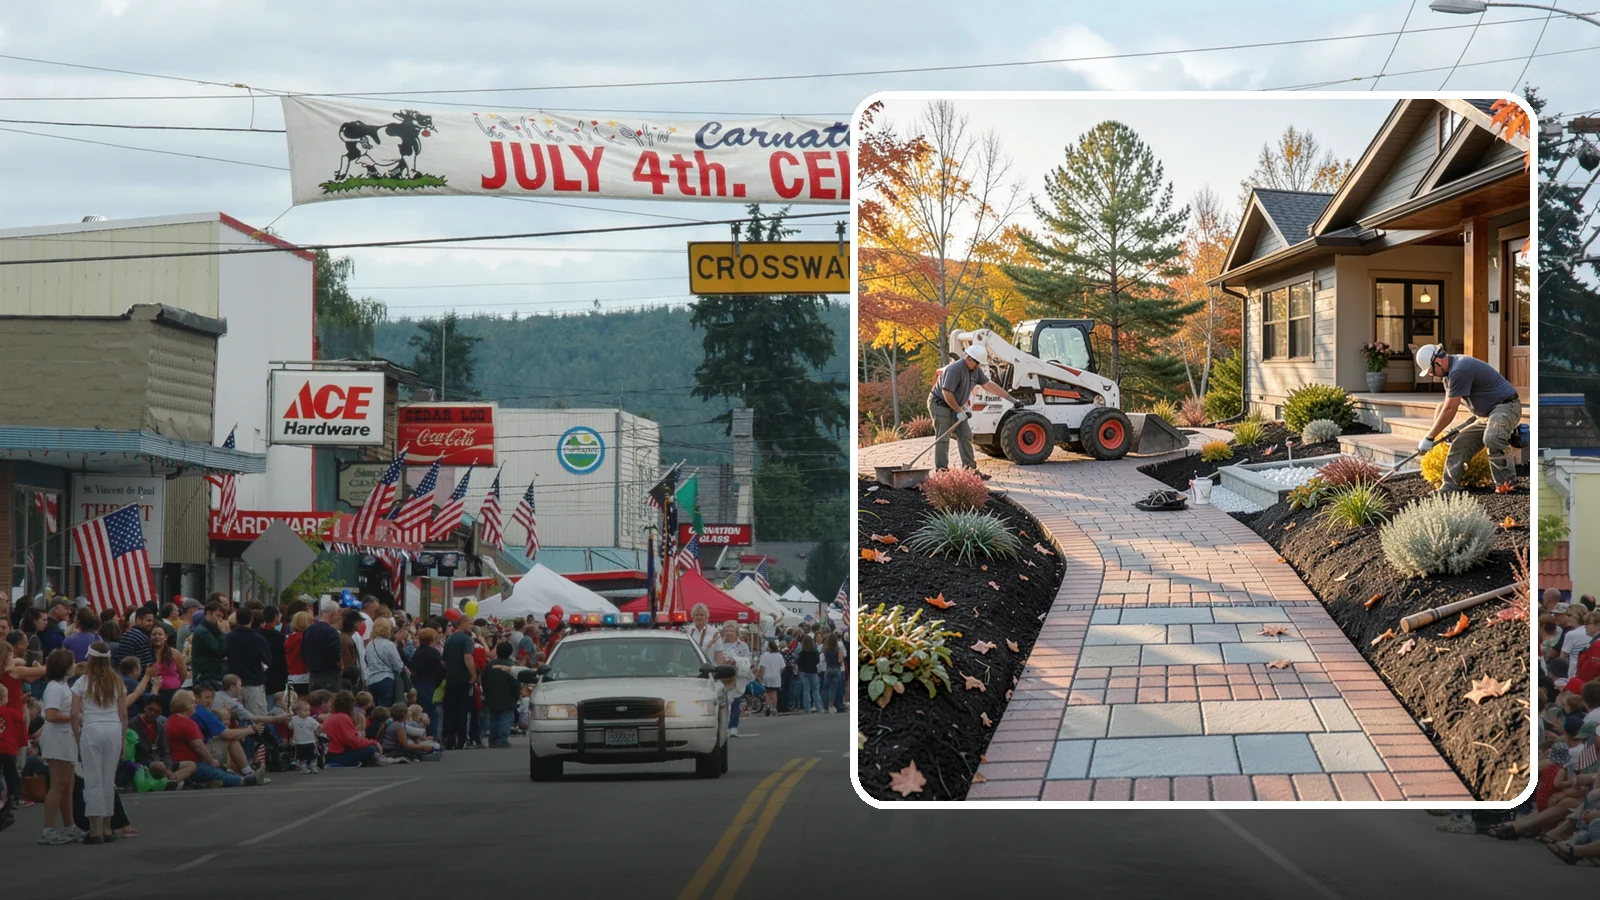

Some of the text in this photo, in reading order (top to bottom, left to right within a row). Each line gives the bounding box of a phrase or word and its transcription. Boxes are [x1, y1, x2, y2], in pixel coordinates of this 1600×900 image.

[481, 141, 605, 192] JULY
[632, 150, 747, 198] 4th.
[283, 380, 373, 420] ACE
[405, 409, 453, 422] CEDAR
[283, 421, 371, 436] Hardware
[416, 428, 477, 447] Coca-Cola
[353, 467, 385, 480] Simpl
[96, 485, 124, 495] Vincent
[126, 486, 135, 495] de
[137, 486, 155, 495] Paul
[688, 526, 741, 535] CRNATION
[699, 535, 730, 543] GLASS
